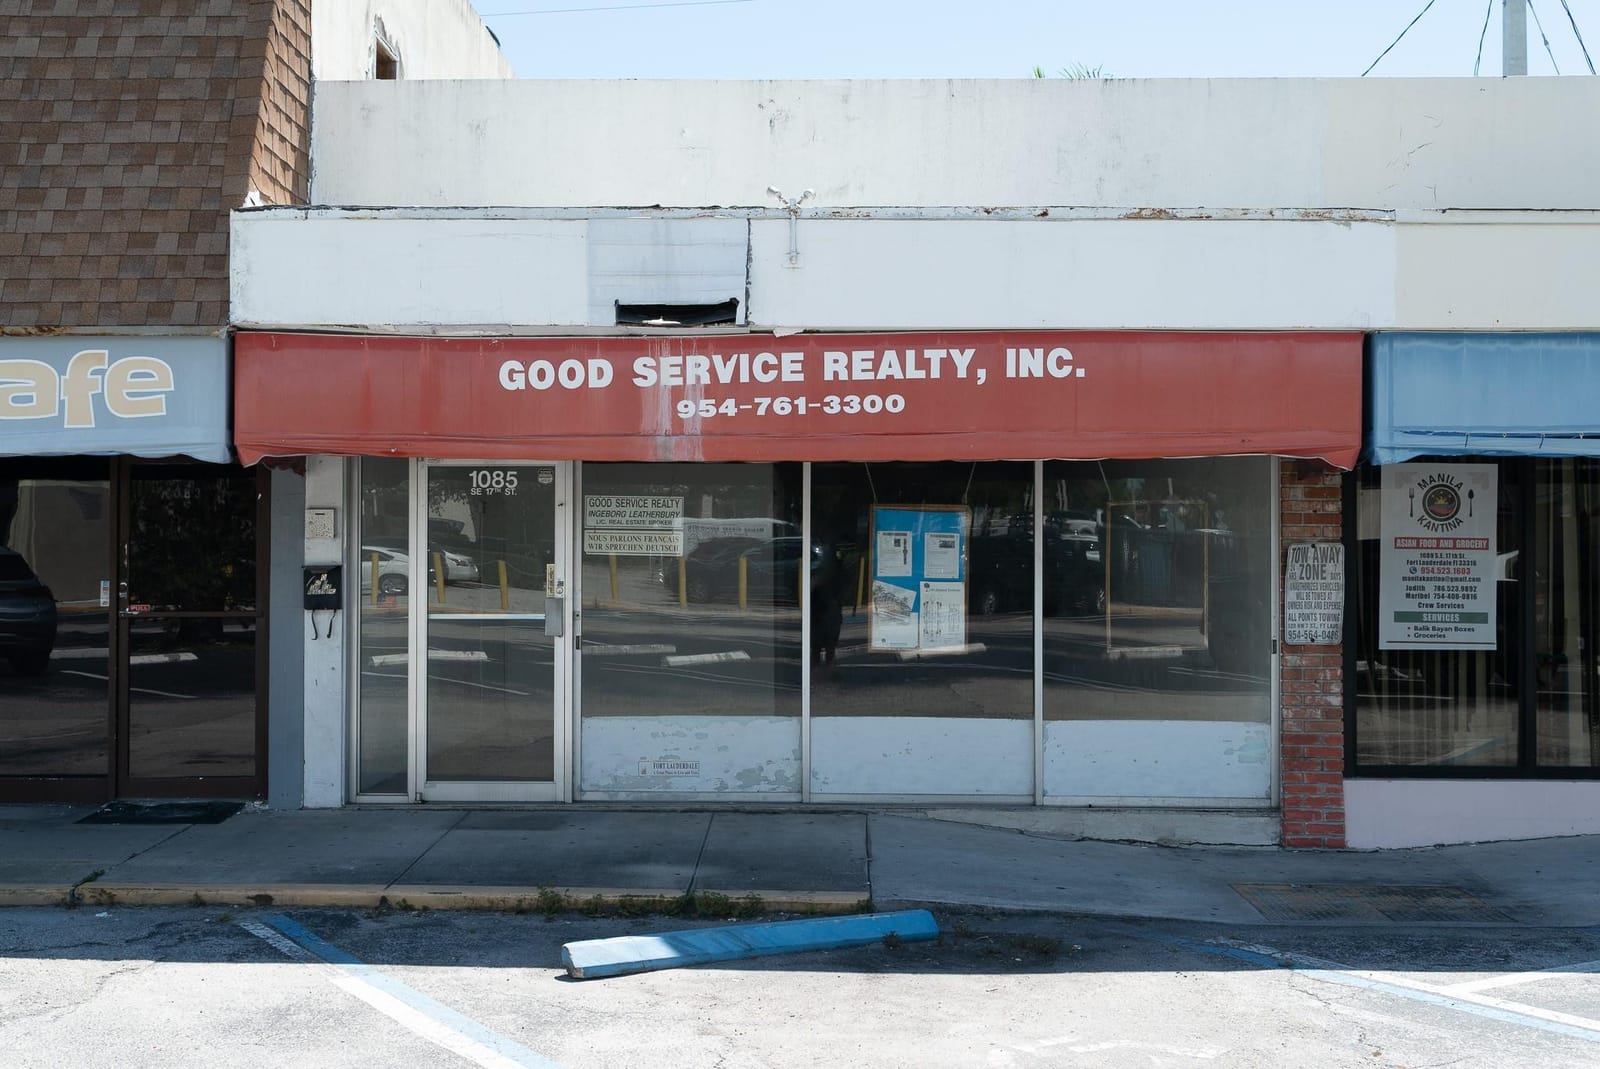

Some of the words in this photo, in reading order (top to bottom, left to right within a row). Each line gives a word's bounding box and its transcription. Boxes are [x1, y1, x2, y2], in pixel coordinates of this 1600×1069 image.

[499, 358, 614, 391] GOOD
[632, 352, 805, 388] SERVICE
[823, 348, 987, 385] REALTY,
[1006, 347, 1086, 378] INC.
[0, 349, 175, 429] afe
[676, 394, 906, 419] 954-761-3300
[468, 470, 518, 488] 1085
[1417, 472, 1464, 491] MANILA
[470, 487, 482, 496] SE
[504, 487, 518, 496] ST.
[588, 497, 612, 508] GOOD
[615, 498, 648, 509] SERVICE
[651, 499, 680, 509] REALTY
[588, 510, 627, 518] INGEBORG
[628, 510, 681, 518] LEATHERBURY
[1416, 514, 1464, 533] KANTINA
[588, 534, 608, 542] NOUS
[609, 535, 642, 543] PARLONS
[1396, 538, 1417, 547] ASIAN
[1420, 538, 1437, 548] FOOD
[1440, 539, 1454, 548] AND
[1456, 539, 1488, 549] GROCERY
[588, 543, 603, 551] WIR
[605, 543, 644, 552] SPRECHEN
[645, 544, 679, 552] DEUTSCH
[1291, 546, 1310, 564] TOW
[1312, 546, 1341, 564] AWAY
[1299, 563, 1327, 580] ZONE
[1420, 567, 1471, 575] 954.523.1603
[1405, 592, 1431, 600] Maribel
[1287, 613, 1297, 622] ALL
[1298, 613, 1318, 622] POINTS
[1319, 613, 1341, 622] TOWING
[1422, 613, 1460, 622] SERVICES
[1431, 625, 1453, 633] Bayan
